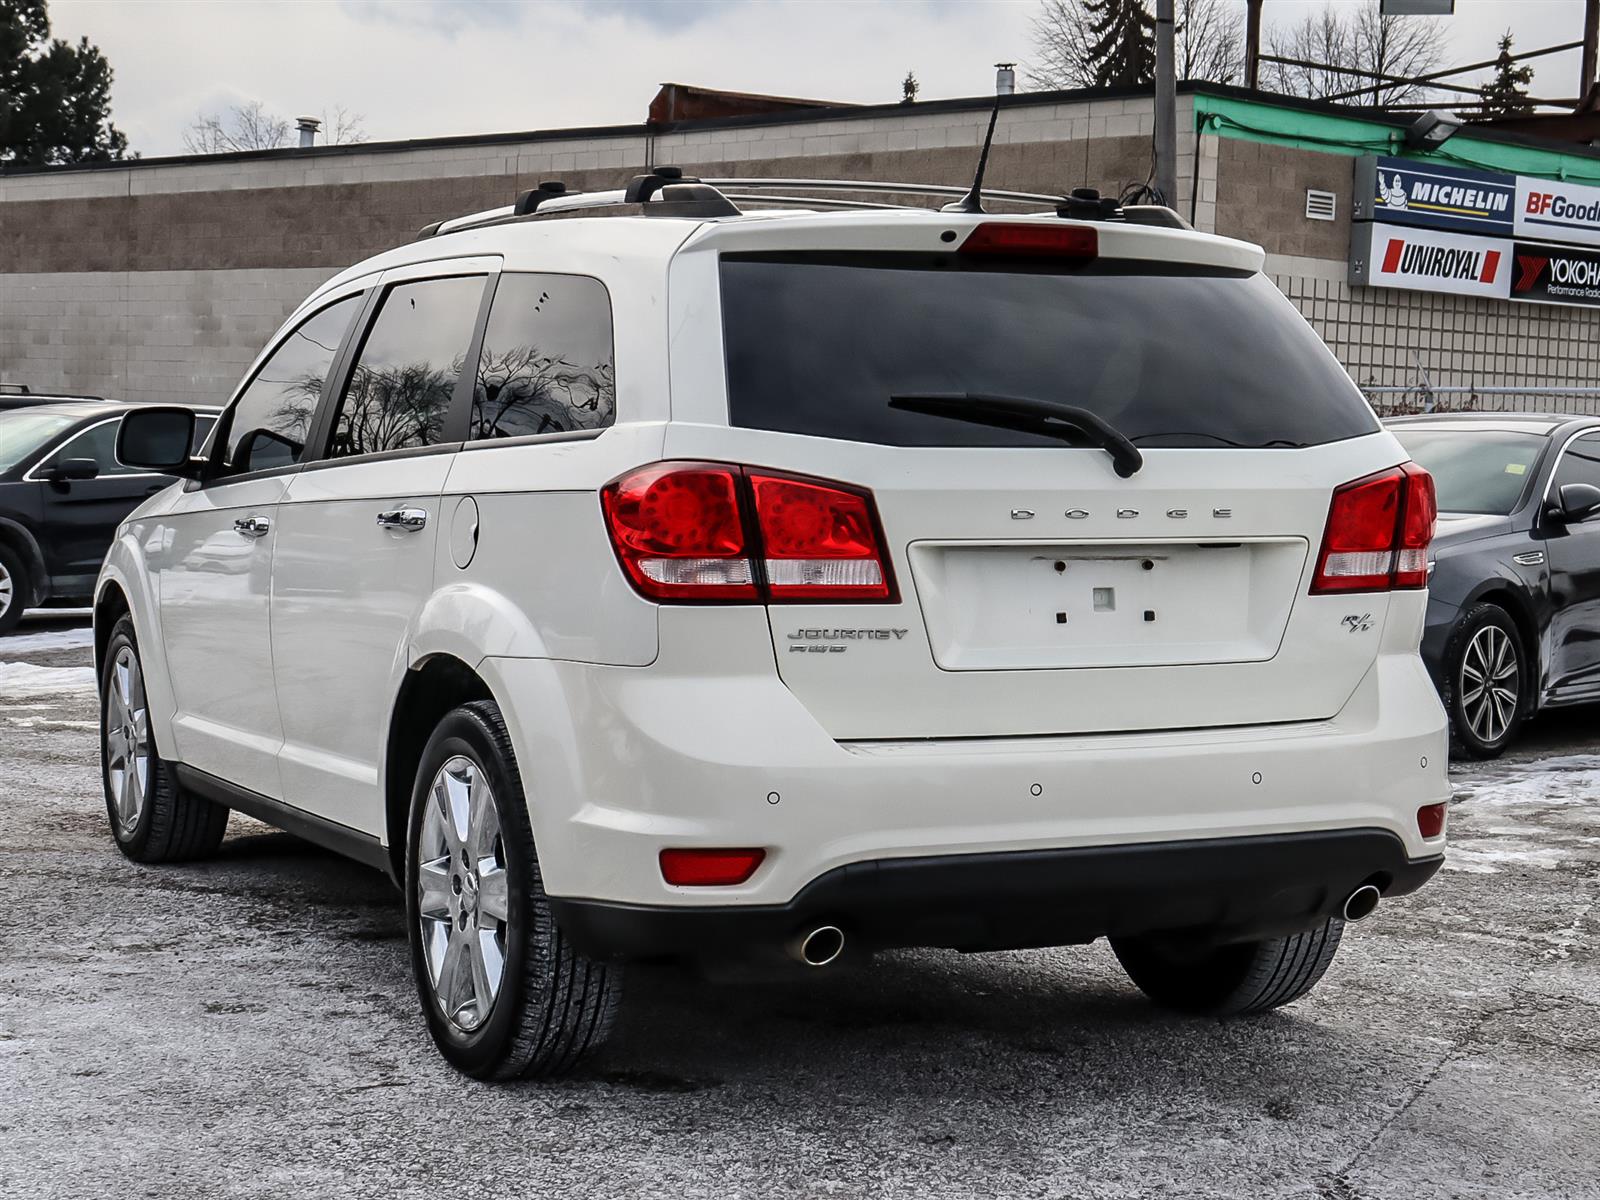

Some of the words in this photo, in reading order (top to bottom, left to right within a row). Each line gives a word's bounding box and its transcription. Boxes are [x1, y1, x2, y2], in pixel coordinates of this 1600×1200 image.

[1411, 181, 1509, 211] MICHELIN
[1401, 243, 1480, 281] UNIROYAL
[1547, 284, 1584, 297] Performance
[1011, 508, 1232, 520] DODGE
[787, 628, 908, 640] JOURNEY
